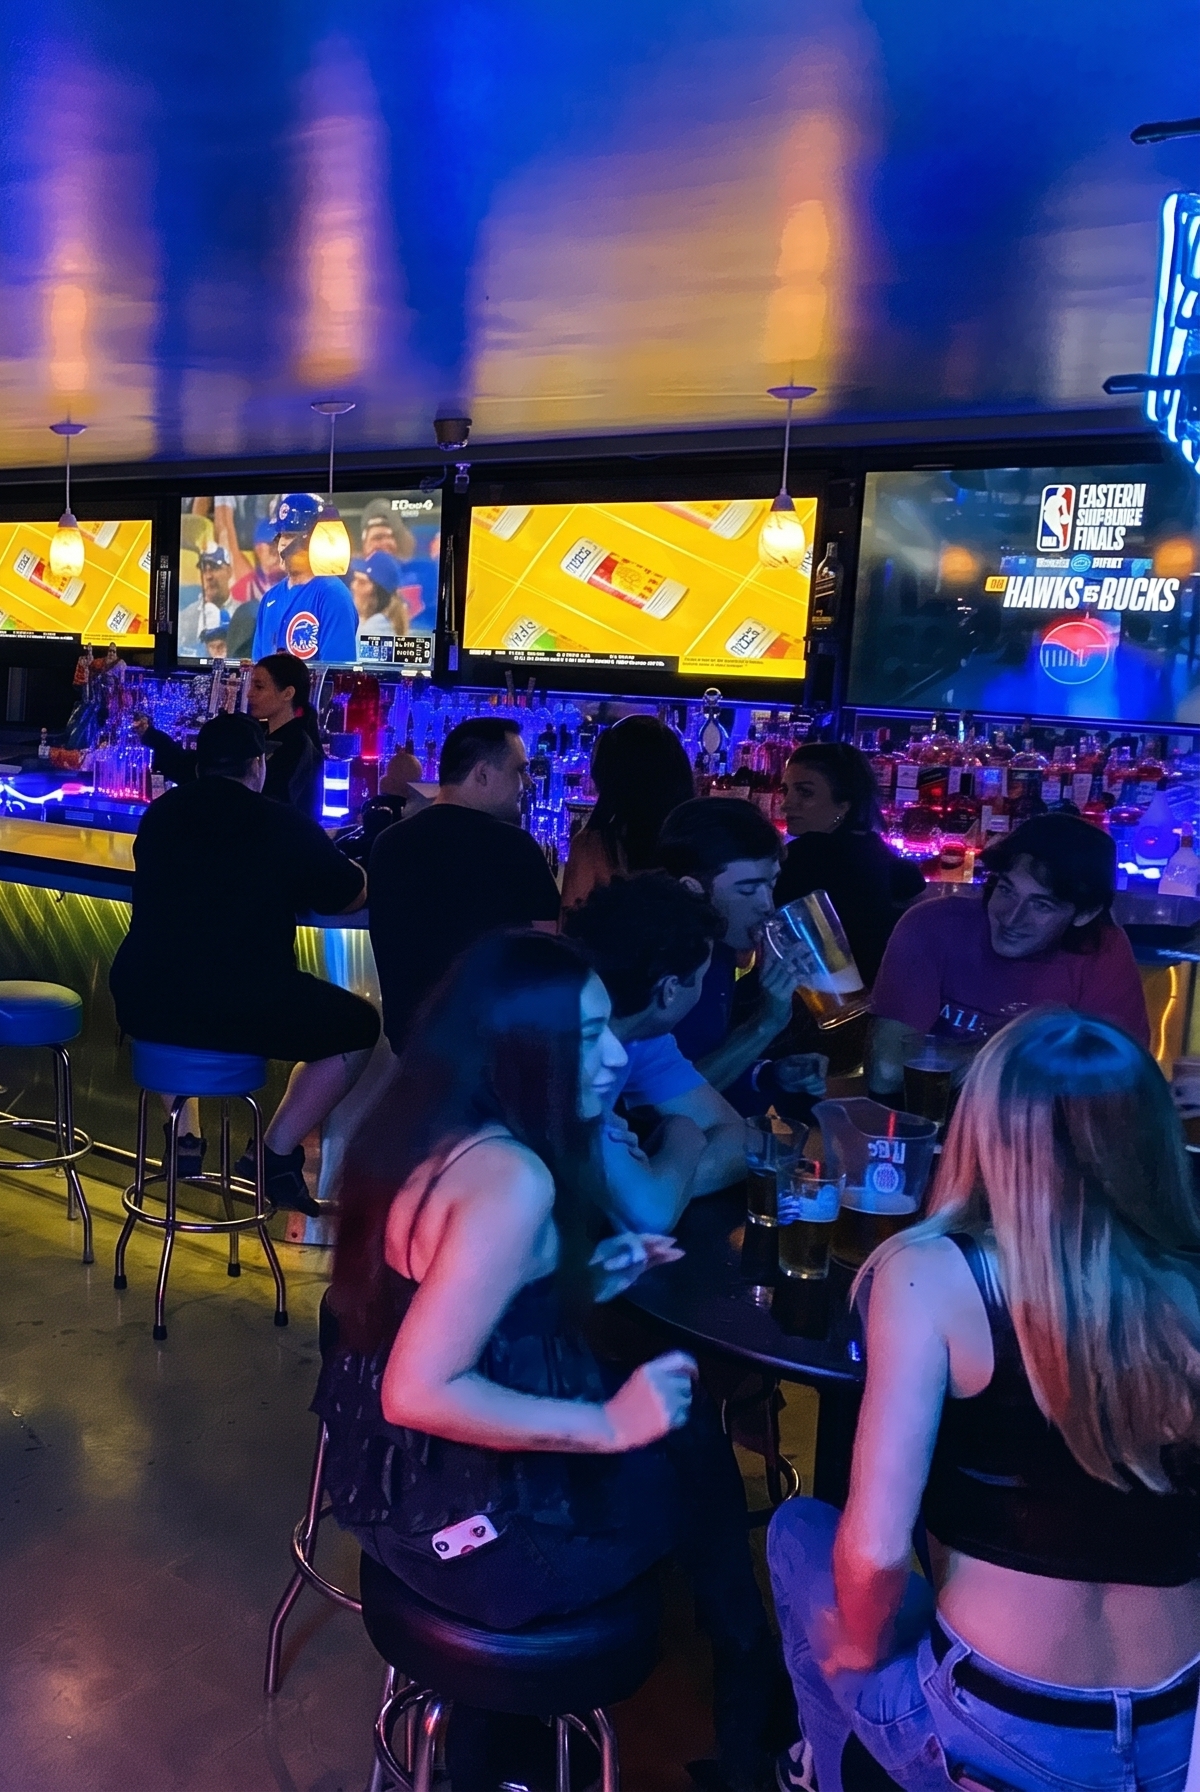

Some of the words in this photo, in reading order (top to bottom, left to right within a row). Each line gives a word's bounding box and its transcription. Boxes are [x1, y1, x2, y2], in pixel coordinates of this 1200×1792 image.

[1078, 483, 1147, 508] EASTERN
[1073, 526, 1126, 551] FINALS
[1003, 576, 1084, 610] HAWKS
[1097, 577, 1180, 612] BUCKS
